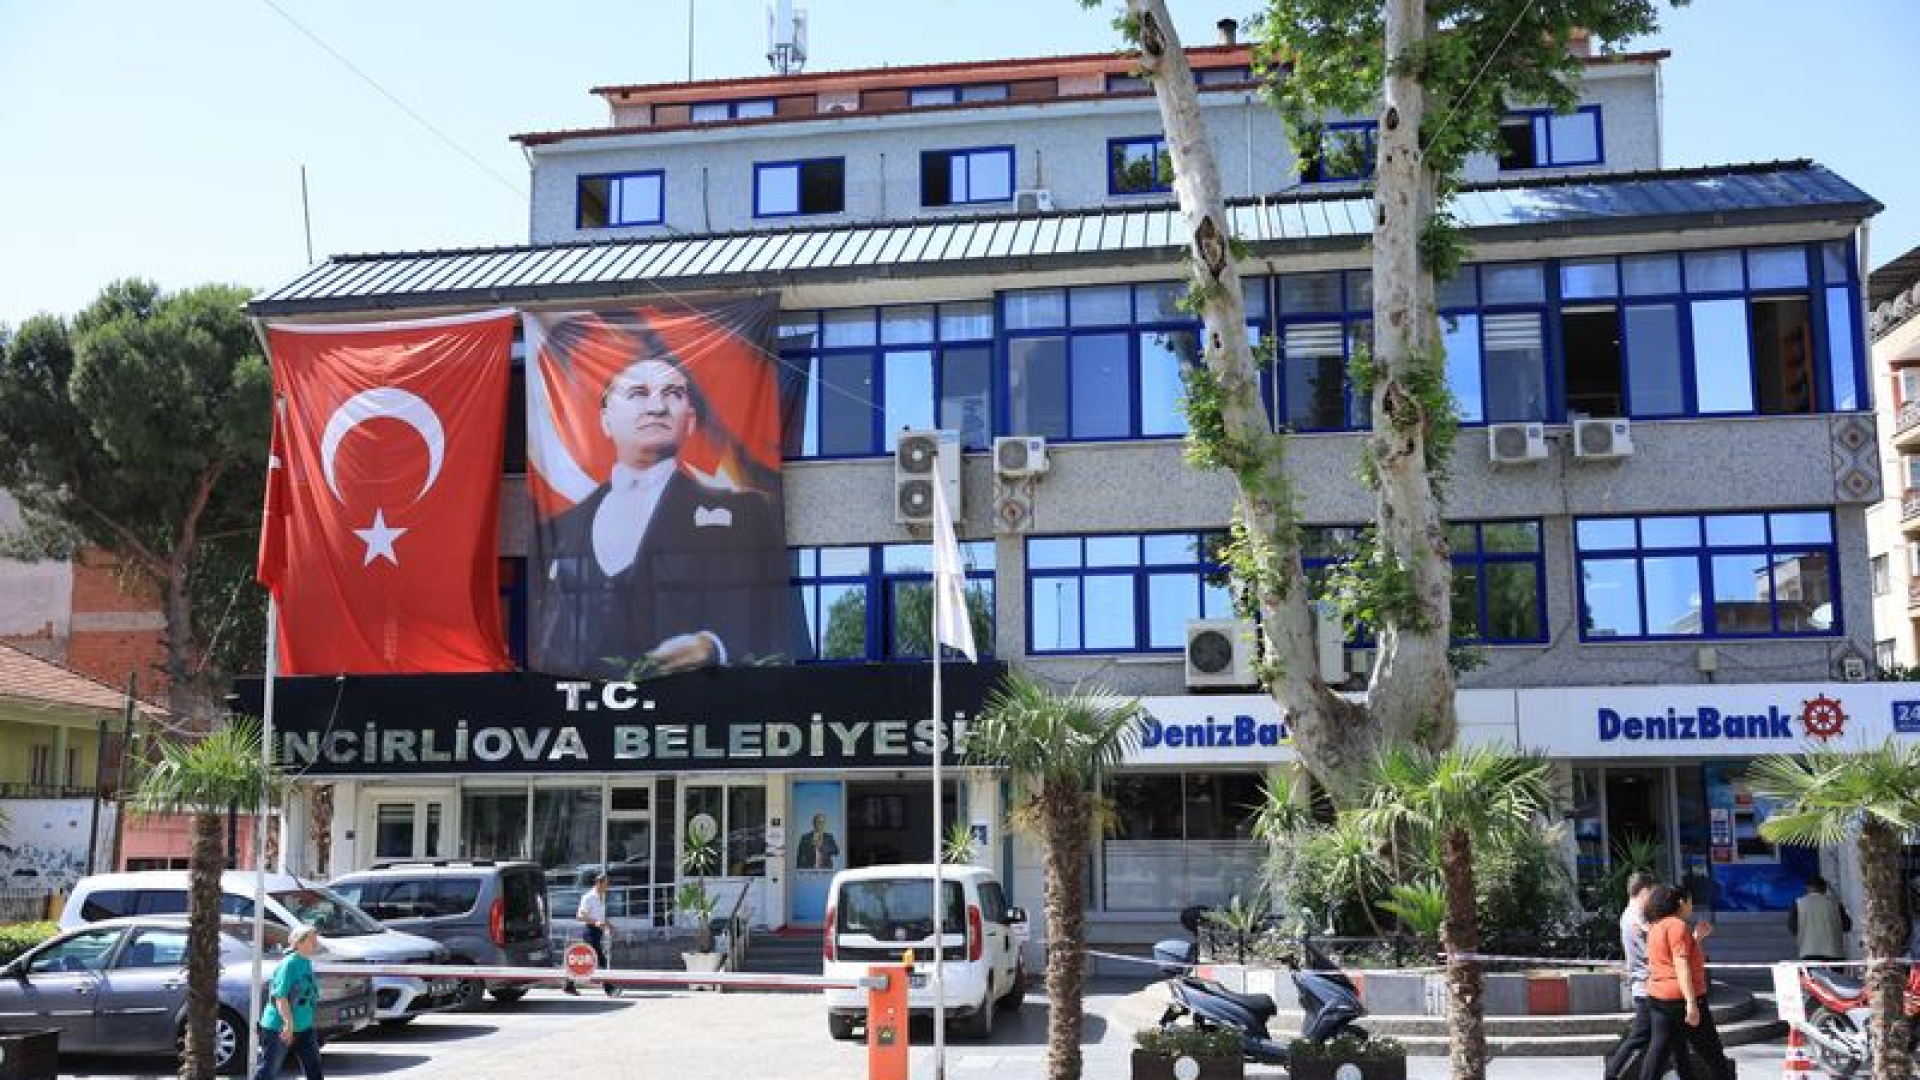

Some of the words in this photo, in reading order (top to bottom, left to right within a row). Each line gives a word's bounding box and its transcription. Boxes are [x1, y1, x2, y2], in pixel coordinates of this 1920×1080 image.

[556, 681, 656, 711] T.C.
[614, 711, 968, 758] BELEDİYESİ
[1597, 705, 1793, 740] DenizBank
